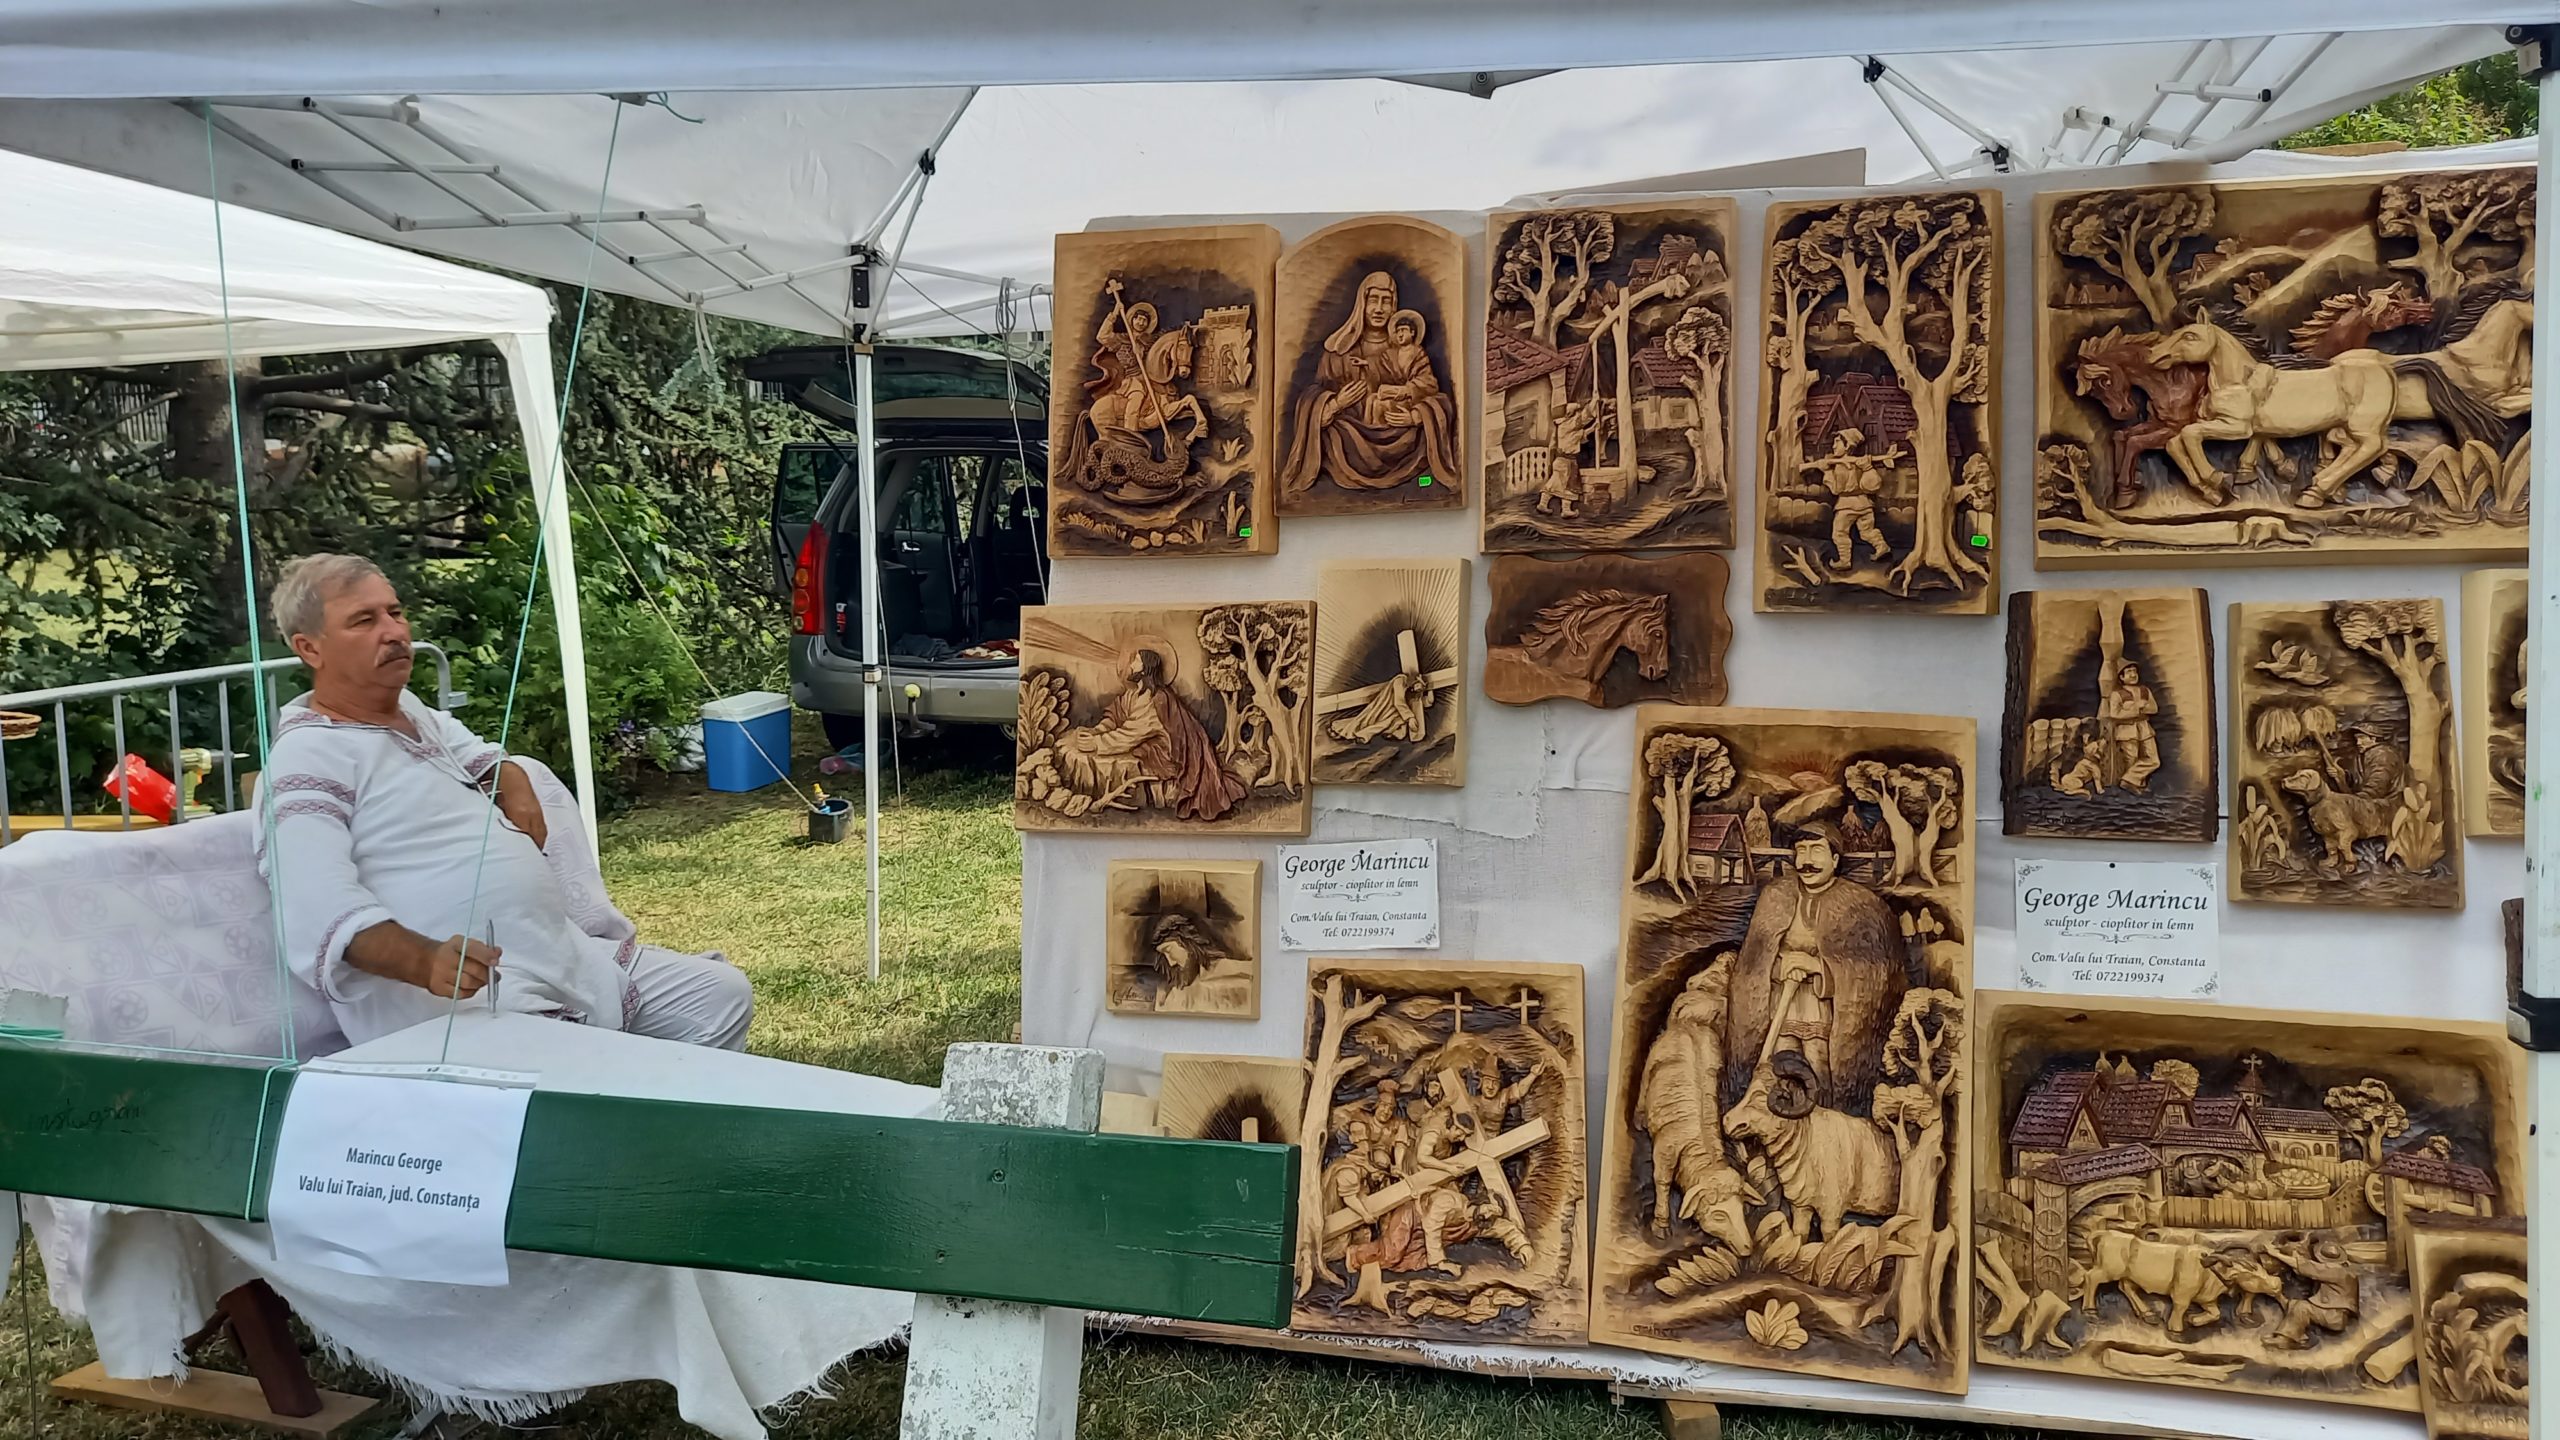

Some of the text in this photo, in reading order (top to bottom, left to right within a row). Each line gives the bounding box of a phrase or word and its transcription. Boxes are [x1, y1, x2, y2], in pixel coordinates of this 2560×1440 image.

[1285, 852, 1431, 879] George Marincu
[1301, 879, 1339, 892] sculptor
[1345, 877, 1384, 891] cioplitor
[1385, 878, 1395, 888] in
[1397, 877, 1419, 888] lemn
[2024, 887, 2208, 913] George Marincu
[1335, 911, 1348, 922] lui
[1349, 911, 1380, 922] Traian,
[1382, 911, 1427, 922] Constanta
[2043, 916, 2090, 932] sculptor
[2100, 917, 2150, 932] cioplitor
[2151, 918, 2163, 930] in
[2166, 918, 2194, 931] lemn
[1341, 927, 1395, 937] 0722199374
[2088, 951, 2103, 964] lui
[2105, 953, 2145, 967] Traian,
[2148, 955, 2206, 968] Constanta
[2072, 969, 2165, 983] Tel: 0722199374
[346, 1147, 443, 1174] Marincu George
[299, 1175, 325, 1194] Valu
[326, 1177, 344, 1196] lui
[346, 1180, 387, 1201] Traian,
[388, 1184, 414, 1205] jud.
